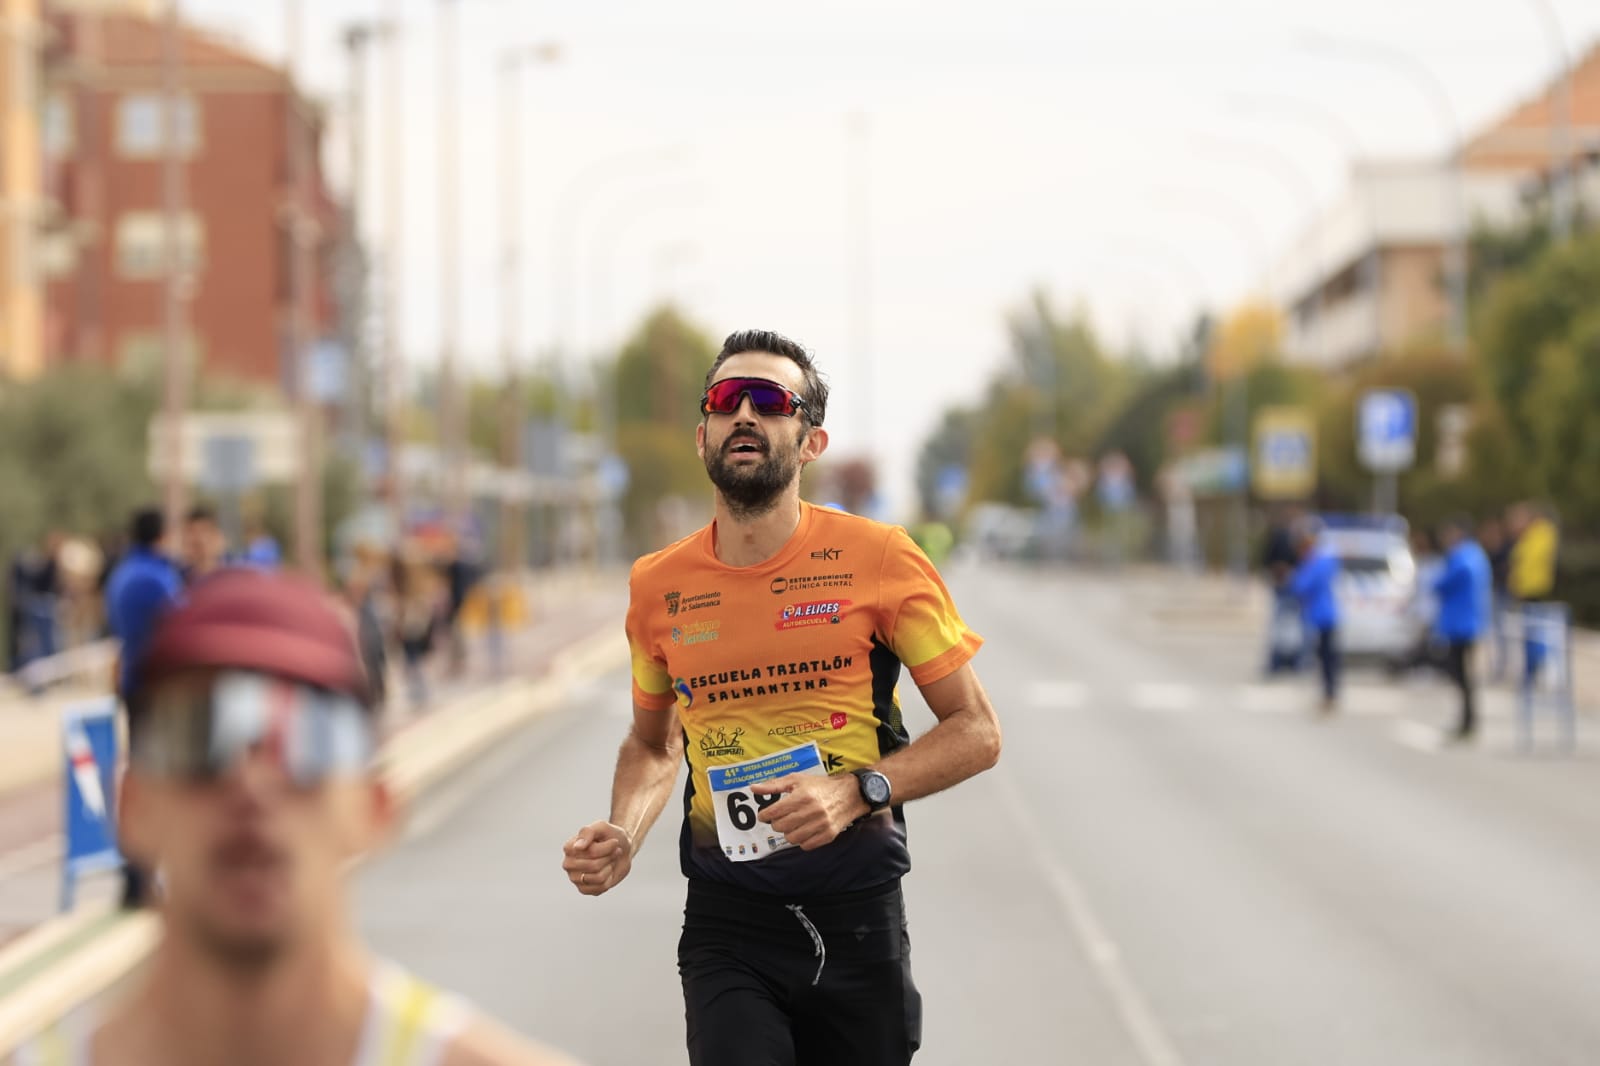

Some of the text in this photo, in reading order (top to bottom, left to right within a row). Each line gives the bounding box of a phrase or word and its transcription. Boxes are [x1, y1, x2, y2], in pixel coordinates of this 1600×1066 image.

[682, 591, 721, 604] Ayuntamiento
[688, 600, 721, 611] Salamanca
[805, 603, 840, 615] ELICES
[783, 617, 828, 628] AUTOESCUELA
[690, 655, 853, 689] ESCUELA TRIATLÓN
[708, 678, 828, 703] SALMANTINA
[768, 718, 828, 736] ACCITRAF
[763, 762, 800, 776] SALAMANCA
